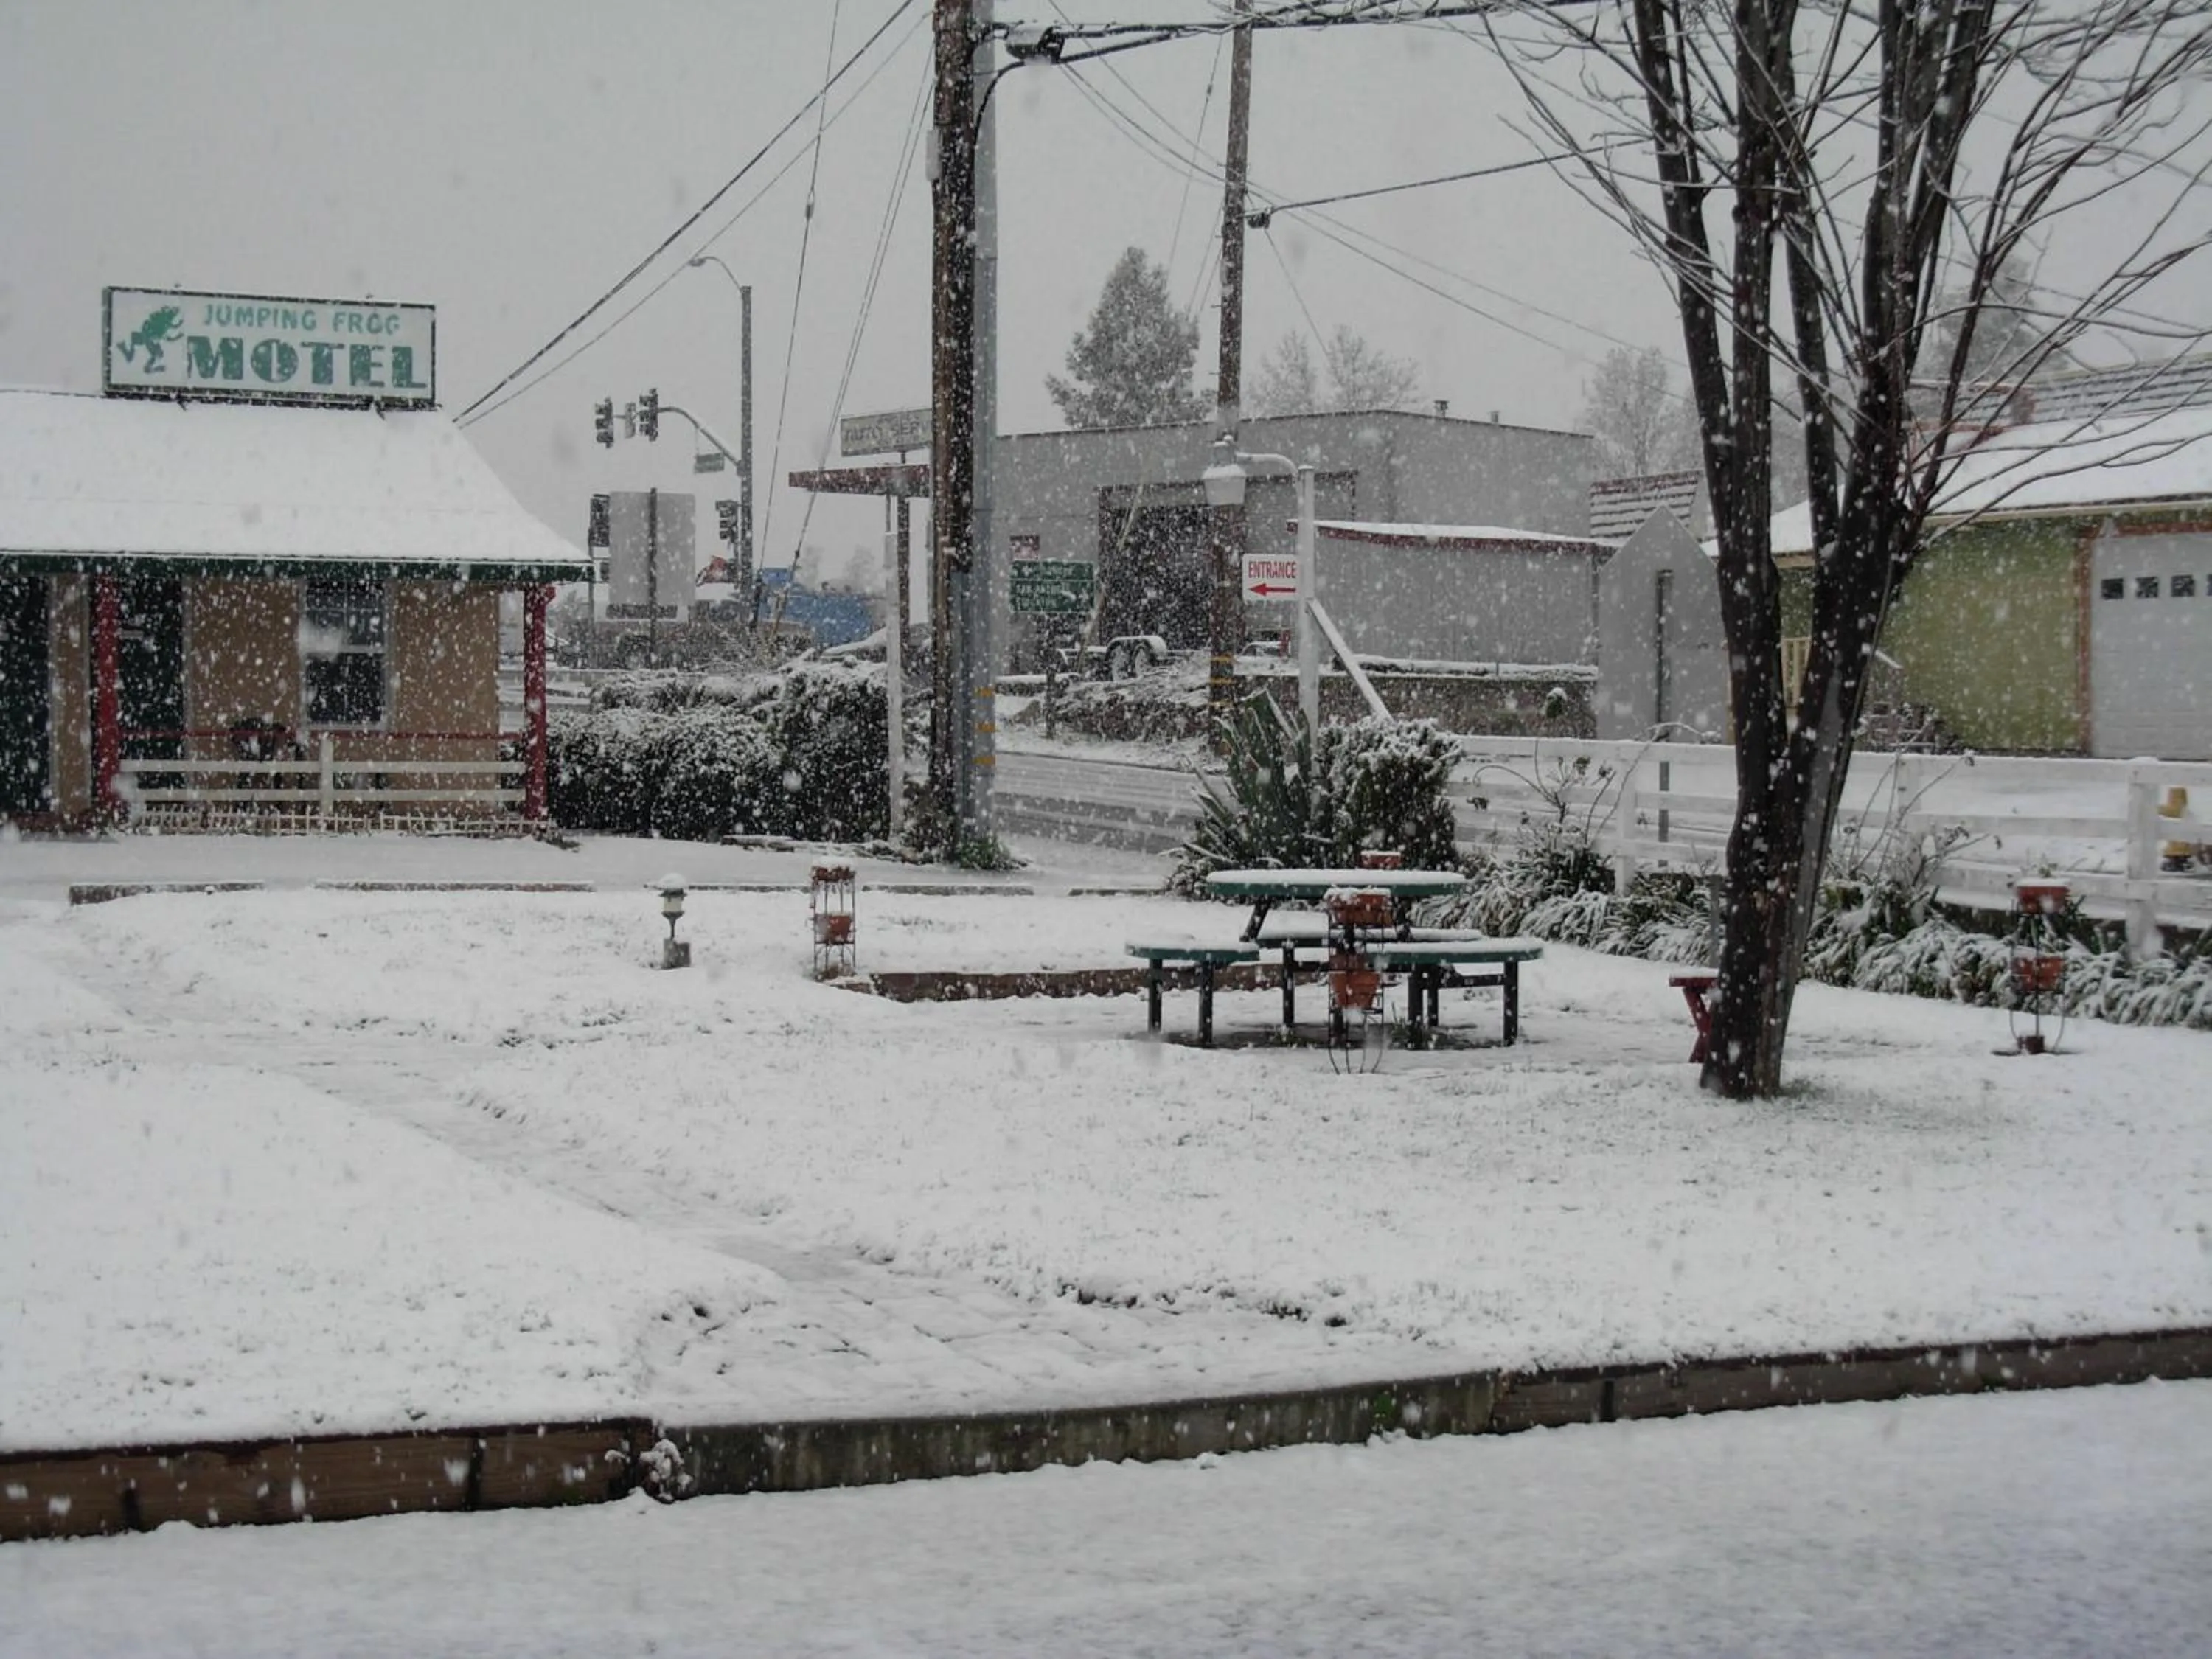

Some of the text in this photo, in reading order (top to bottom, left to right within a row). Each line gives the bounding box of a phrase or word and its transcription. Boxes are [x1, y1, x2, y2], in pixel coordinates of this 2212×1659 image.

[203, 303, 400, 335] JUMPING FROG
[187, 335, 428, 389] MOTEL
[1248, 561, 1297, 579] ENTRANCE
